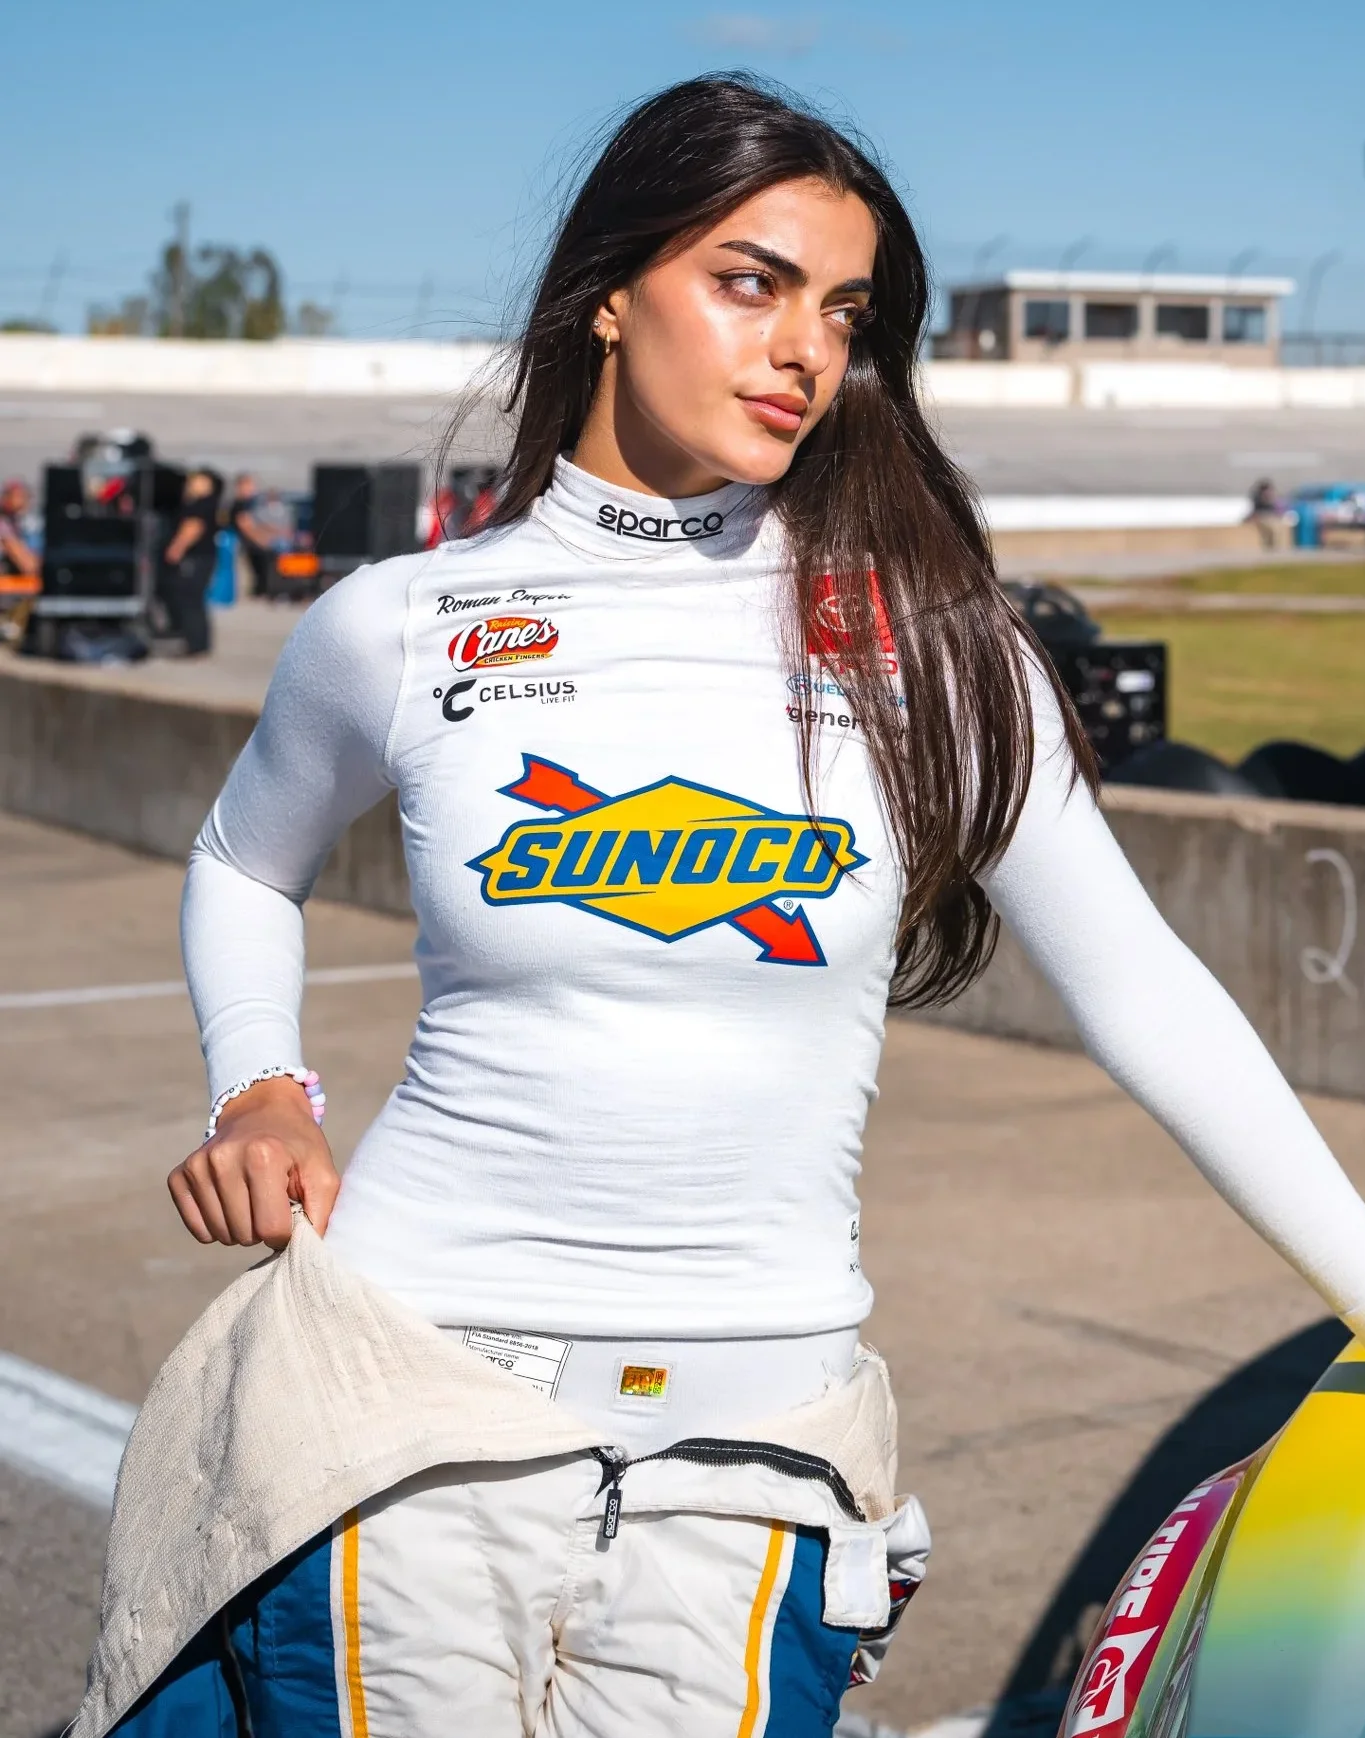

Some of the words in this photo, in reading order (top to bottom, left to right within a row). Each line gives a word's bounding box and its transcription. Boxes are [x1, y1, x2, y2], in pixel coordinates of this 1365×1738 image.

[597, 504, 724, 542] sparco
[437, 595, 501, 616] Roman
[489, 618, 527, 630] Raising
[452, 617, 559, 673] Cane's
[484, 655, 513, 664] CHICKEN
[515, 653, 546, 661] FINGERS
[541, 696, 560, 705] LIVE
[563, 695, 576, 703] FIT
[497, 828, 842, 892] SUNOCO
[482, 1334, 508, 1344] Standard
[605, 1498, 618, 1537] sparco
